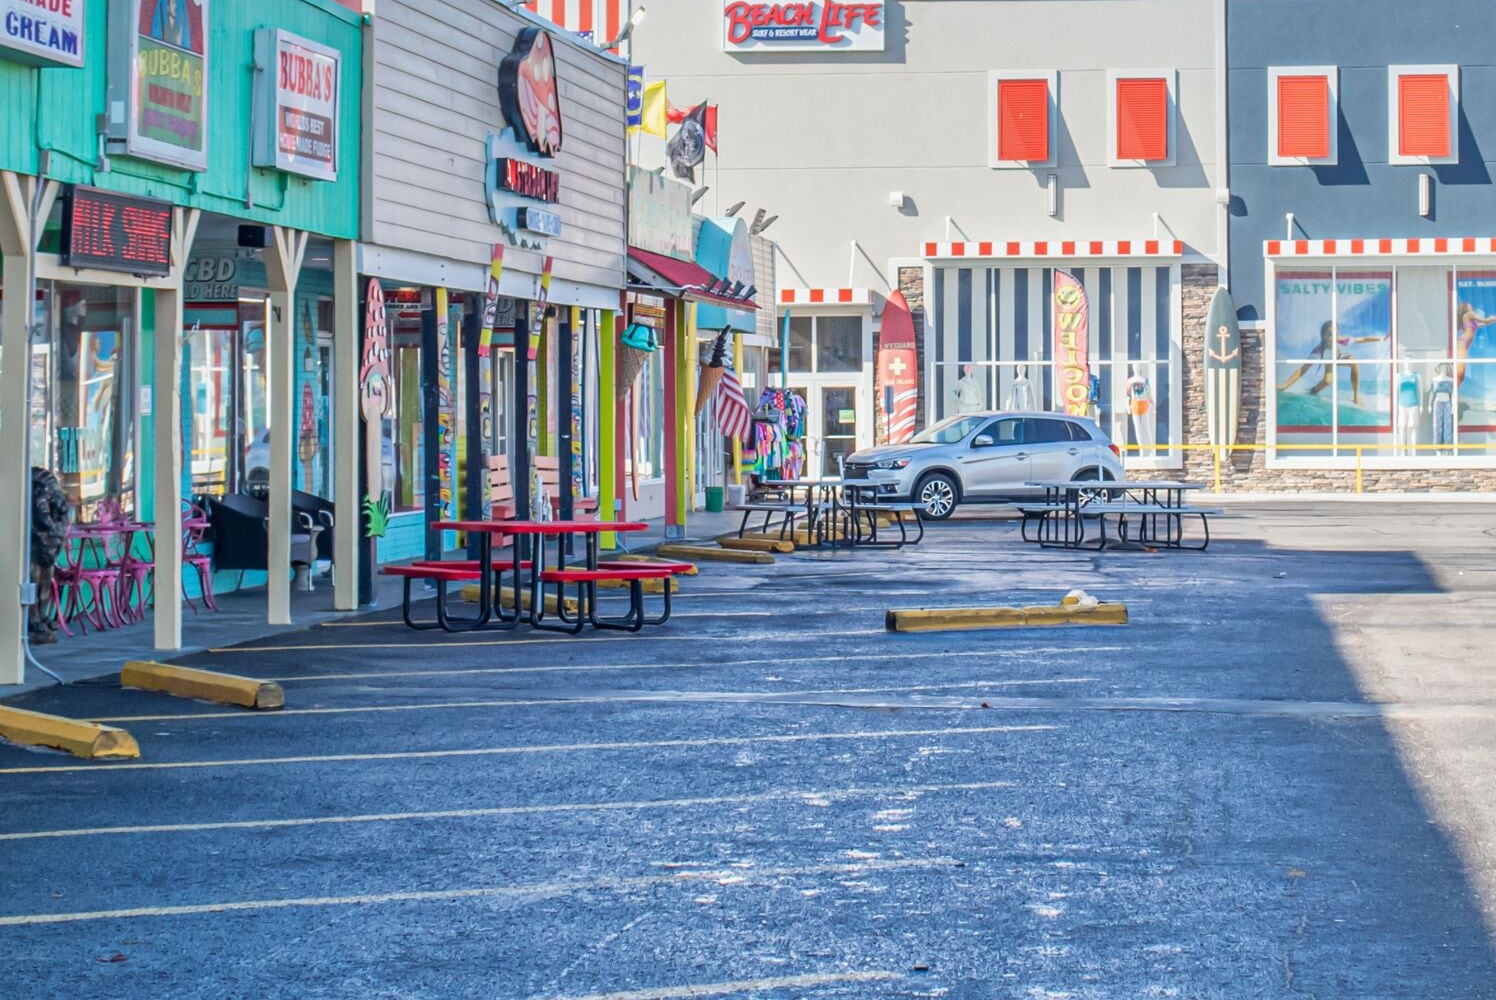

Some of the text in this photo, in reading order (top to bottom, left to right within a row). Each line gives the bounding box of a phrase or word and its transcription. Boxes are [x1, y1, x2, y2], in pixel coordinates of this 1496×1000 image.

[724, 0, 815, 44] BEACH
[6, 11, 78, 56] CREAM
[752, 28, 817, 37] SURF & RESORT WEAR
[279, 50, 332, 103] BUBBA'S
[309, 118, 325, 136] BEST
[203, 284, 239, 299] HERE
[1280, 282, 1386, 296] SALTY VIBES
